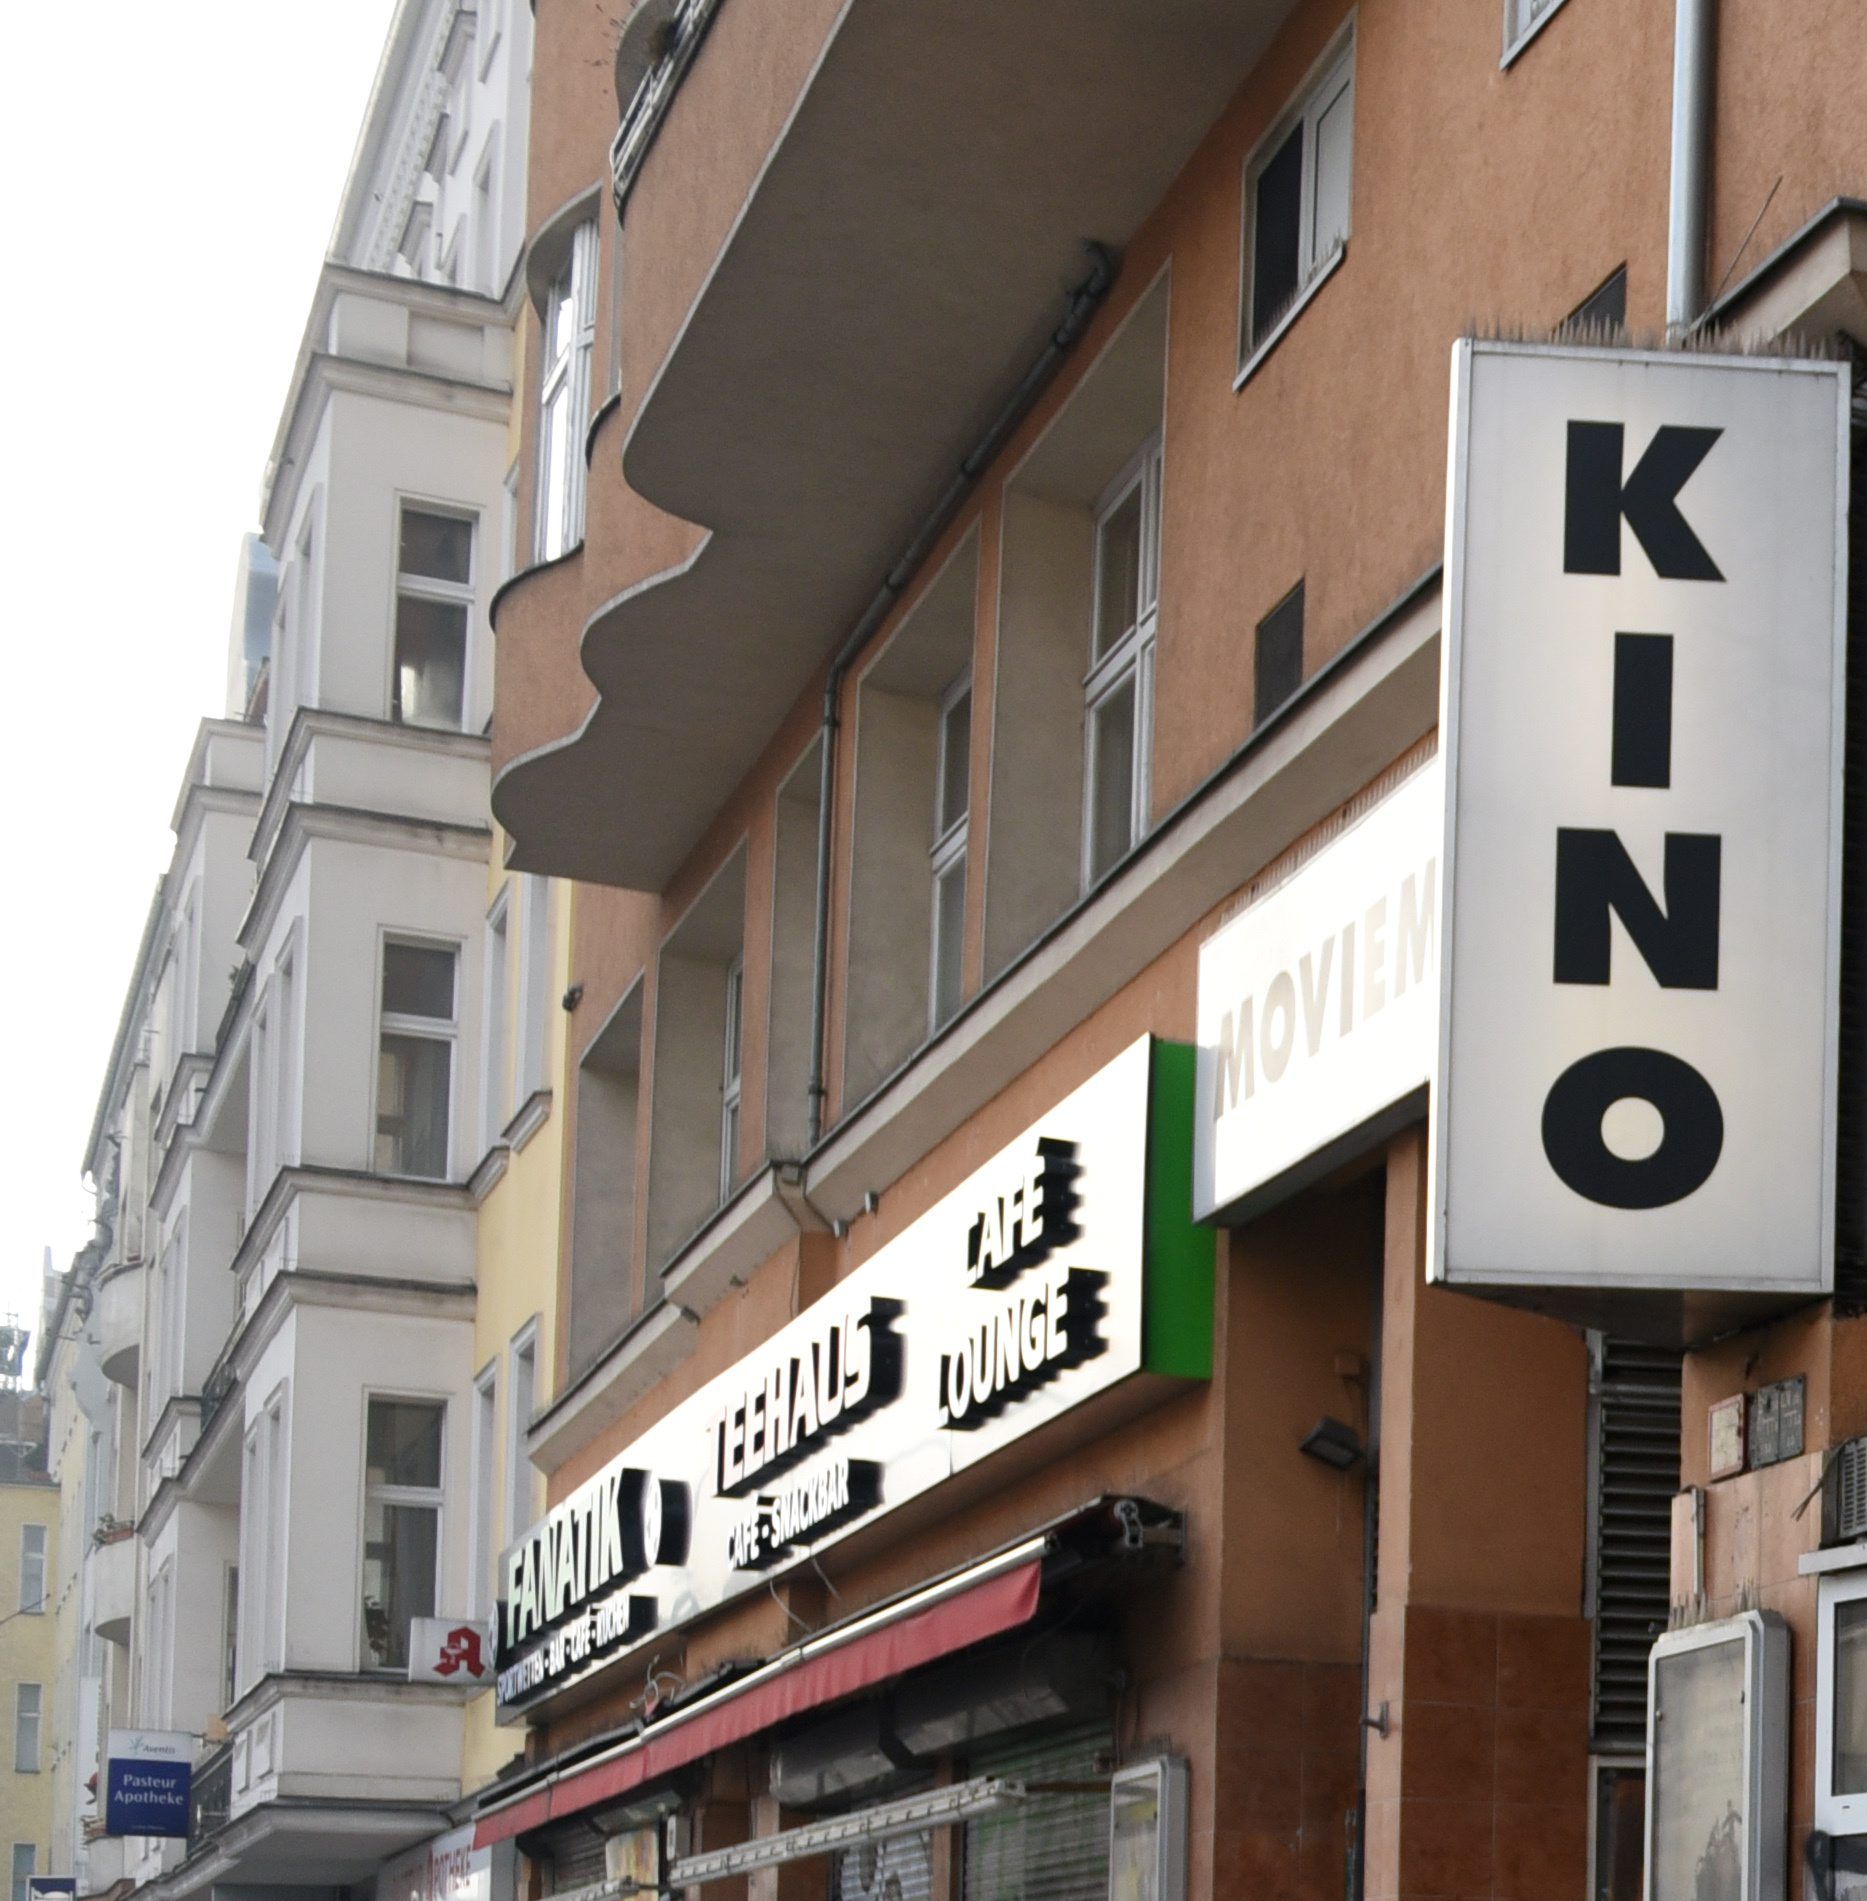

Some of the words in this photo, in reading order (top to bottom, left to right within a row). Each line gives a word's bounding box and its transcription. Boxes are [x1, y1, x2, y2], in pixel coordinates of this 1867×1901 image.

[1541, 419, 1727, 1210] KINO
[708, 1297, 873, 1497] TEEHAUS
[938, 1266, 1070, 1429] LOUNGE
[507, 1468, 624, 1649] FANATIK
[771, 1458, 850, 1549] SNACKBAR
[114, 1790, 184, 1805] Apotheke
[123, 1774, 177, 1789] Pasteur
